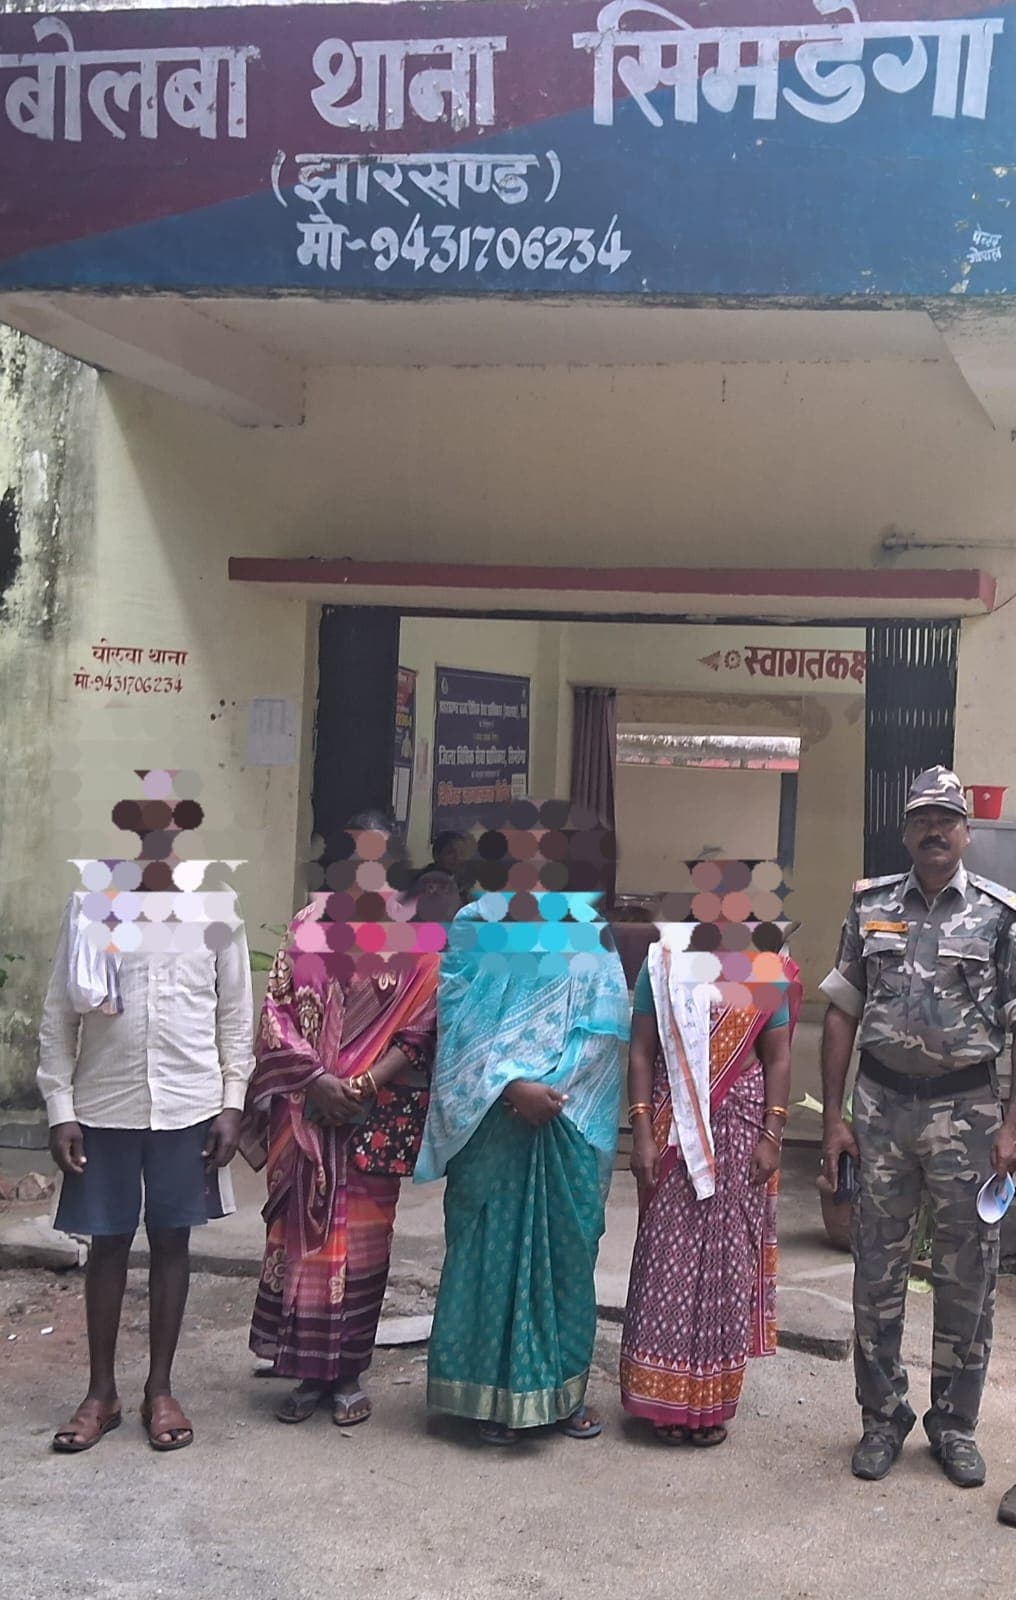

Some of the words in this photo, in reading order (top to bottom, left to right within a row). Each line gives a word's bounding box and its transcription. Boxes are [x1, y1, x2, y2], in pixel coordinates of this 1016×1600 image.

[0, 17, 260, 142] बोलबा
[311, 36, 507, 132] थाना
[573, 0, 1004, 127] सिमडेगा
[147, 648, 188, 666] थाना
